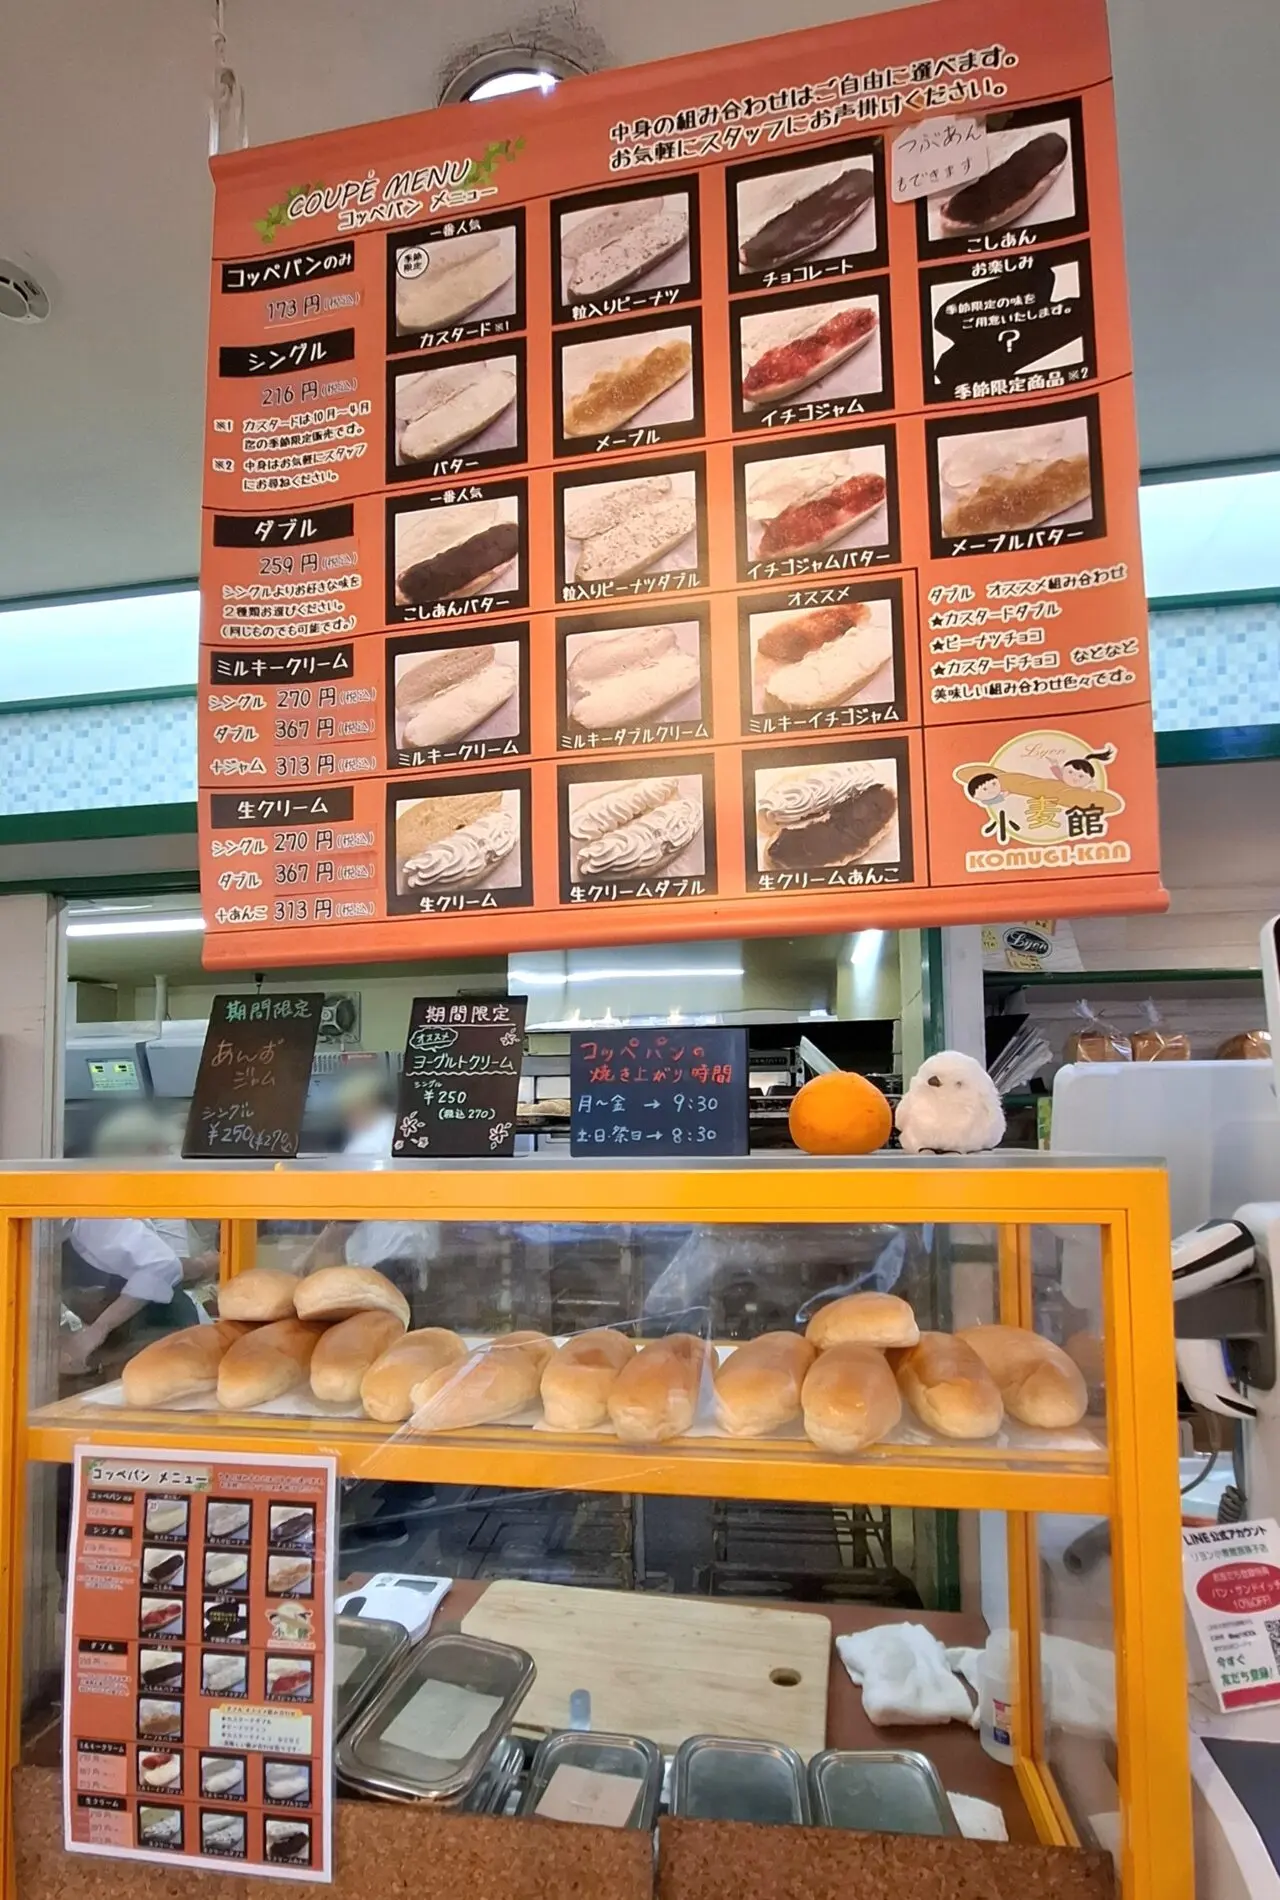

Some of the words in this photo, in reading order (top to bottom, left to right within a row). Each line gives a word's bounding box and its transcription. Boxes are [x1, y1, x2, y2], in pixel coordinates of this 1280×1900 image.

[610, 46, 1018, 142] 中身の組み合わせはご自由に選べます。
[610, 77, 1007, 171] お気軽にスタッフにお声掛けください。
[898, 125, 982, 152] つぶあん
[383, 160, 471, 198] MENU
[899, 157, 972, 192] もできます
[339, 200, 421, 230] コッペパン
[431, 188, 498, 212] メニュー
[430, 219, 481, 237] 一番人気
[967, 231, 1036, 253] こしあん
[227, 253, 352, 289] コッペパンのみ
[763, 259, 853, 287] チョコレート
[971, 256, 1034, 277] お楽しみ
[573, 289, 679, 320] 粒入りピーナツ
[945, 293, 1036, 315] 季節限定の味を
[962, 305, 1071, 329] ご用意いたします。
[420, 323, 490, 349] カスタード
[249, 341, 327, 371] シングル
[954, 371, 1064, 399] 季節限定商品
[762, 399, 865, 426] イチゴジャム
[596, 429, 660, 452] メープル
[433, 458, 479, 476] バター
[430, 487, 483, 503] 一番人気
[254, 518, 317, 542] ダブル
[952, 529, 1084, 556] メープルバター
[748, 550, 890, 579] イチゴジャムバター
[223, 575, 361, 600] シングルよりお好きな味を
[563, 572, 700, 601] 粒入りピーナツダブル
[788, 587, 850, 606] オススメ
[930, 586, 974, 603] ダブル
[987, 566, 1127, 597] オススメ組み合わせ
[404, 597, 510, 622] こしあんバター
[1072, 640, 1138, 664] などなど
[217, 652, 349, 677] ミルキークリーム
[933, 671, 1135, 701] 美味しい組み合わせ色々です。
[208, 696, 267, 712] シングル
[749, 706, 899, 734] ミルキーイチゴジャム
[214, 725, 259, 744] ダブル
[561, 724, 708, 749] ミルキーダブルクリーム
[398, 740, 520, 767] ミルキークリーム
[237, 797, 329, 820] 生クリーム
[985, 797, 1105, 841] 小麦館
[212, 839, 268, 858] シングル
[969, 845, 1128, 869] KOMUGI-KAN
[218, 872, 262, 890] ダブル
[570, 880, 706, 902] 生クリームダブル
[758, 868, 900, 891] 生クリームあんこ
[419, 893, 498, 912] 生クリーム
[1007, 931, 1048, 951] Lyon
[226, 998, 312, 1022] 期間限定
[425, 1004, 510, 1023] 期間限定
[211, 1038, 285, 1067] あんず
[580, 1036, 705, 1061] コッペパンの
[413, 1053, 514, 1070] ヨーグルトクリーム
[590, 1064, 732, 1084] 焼き上がり時間
[202, 1102, 255, 1120] シングル
[673, 1094, 718, 1113] 9:30
[672, 1126, 717, 1144] 8:30
[93, 1468, 150, 1482] コッペパン
[159, 1472, 208, 1485] メニュー
[1217, 1655, 1245, 1668] 今すぐ
